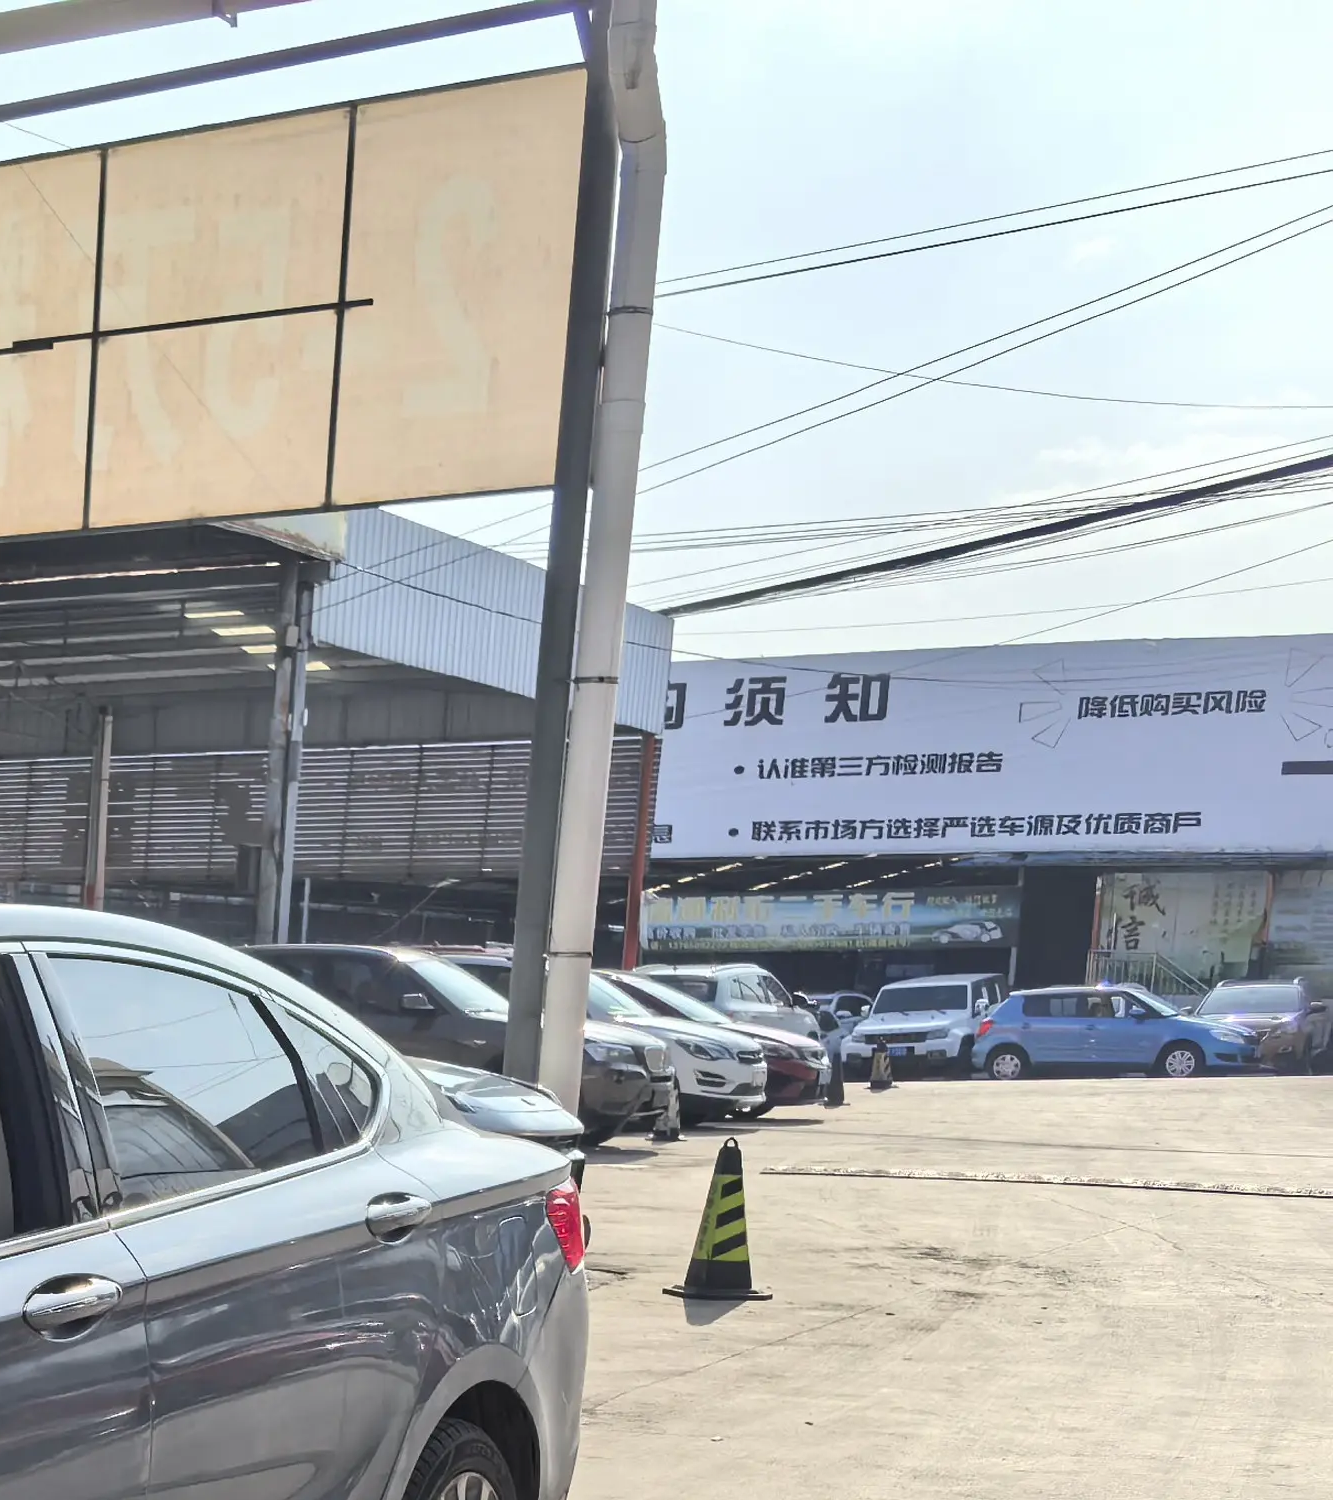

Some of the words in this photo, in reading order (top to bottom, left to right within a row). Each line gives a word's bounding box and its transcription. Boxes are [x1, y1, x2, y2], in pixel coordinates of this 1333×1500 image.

[1077, 689, 1267, 720] 降低购买风险
[757, 751, 1004, 780] 认准第三方检测报告
[751, 812, 1202, 842] 联系市场方选择严选车源及优质商户
